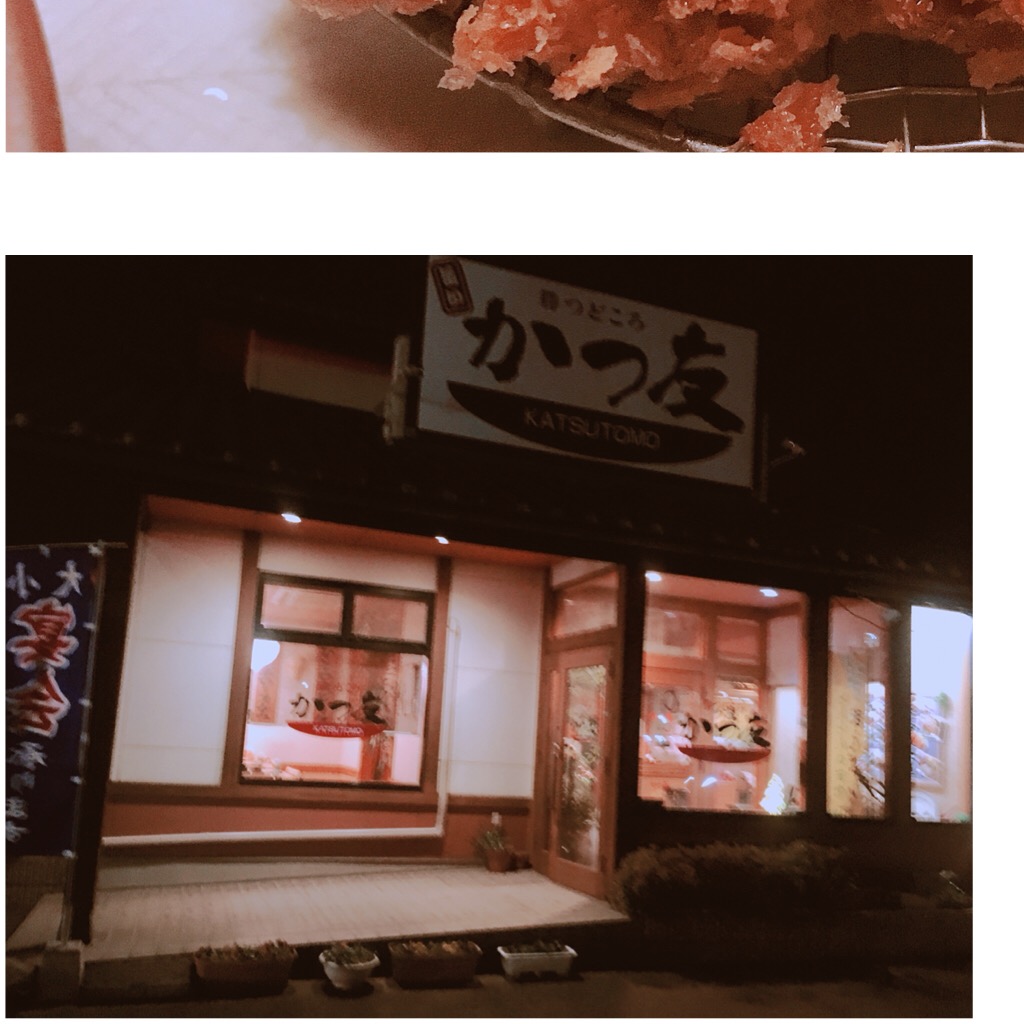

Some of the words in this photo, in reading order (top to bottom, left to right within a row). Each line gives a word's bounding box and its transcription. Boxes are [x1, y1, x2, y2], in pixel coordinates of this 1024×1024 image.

[462, 295, 745, 434] かつ友
[522, 407, 661, 451] KATSUTOMO
[290, 690, 387, 725] かつ友
[312, 724, 365, 737] KATSUTOMO
